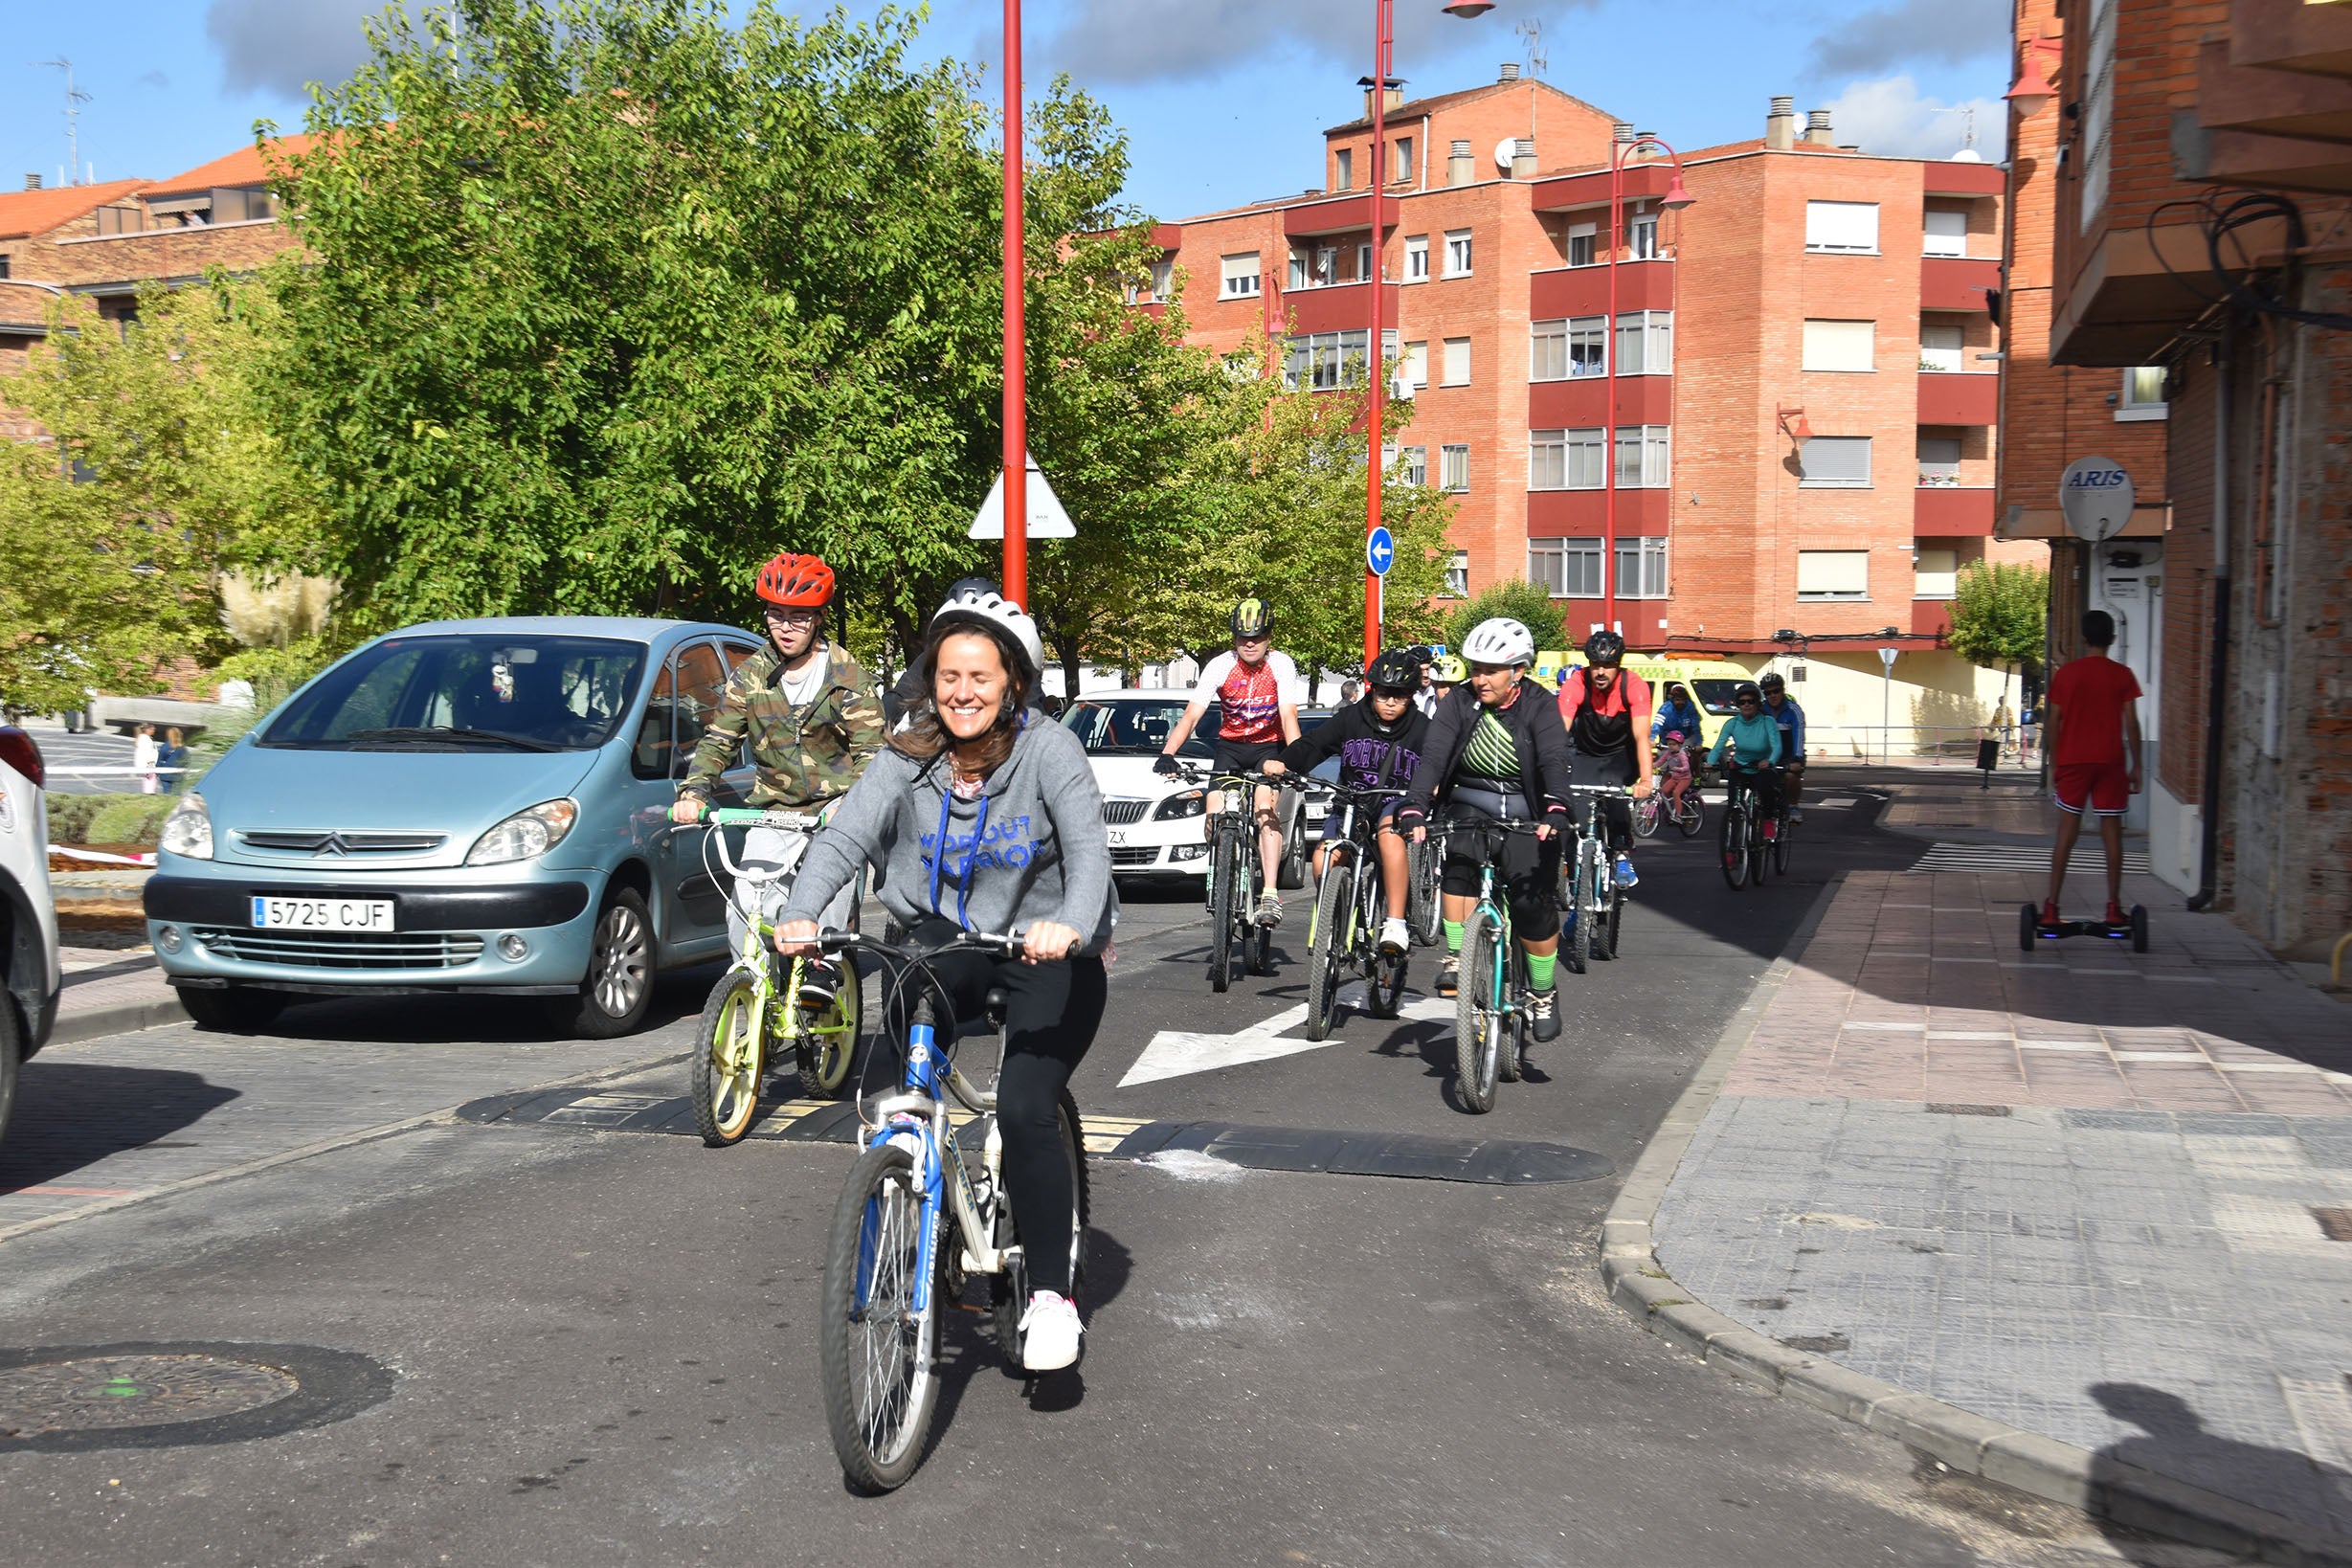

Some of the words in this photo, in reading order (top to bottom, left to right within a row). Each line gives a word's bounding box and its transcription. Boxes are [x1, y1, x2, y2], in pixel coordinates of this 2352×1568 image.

[2068, 469, 2127, 487] ARIS
[1342, 738, 1391, 769] PORTS
[918, 815, 1030, 854] WOROUT
[920, 839, 1046, 879] ARRIOR
[271, 902, 329, 926] 5725
[341, 904, 385, 927] CJF
